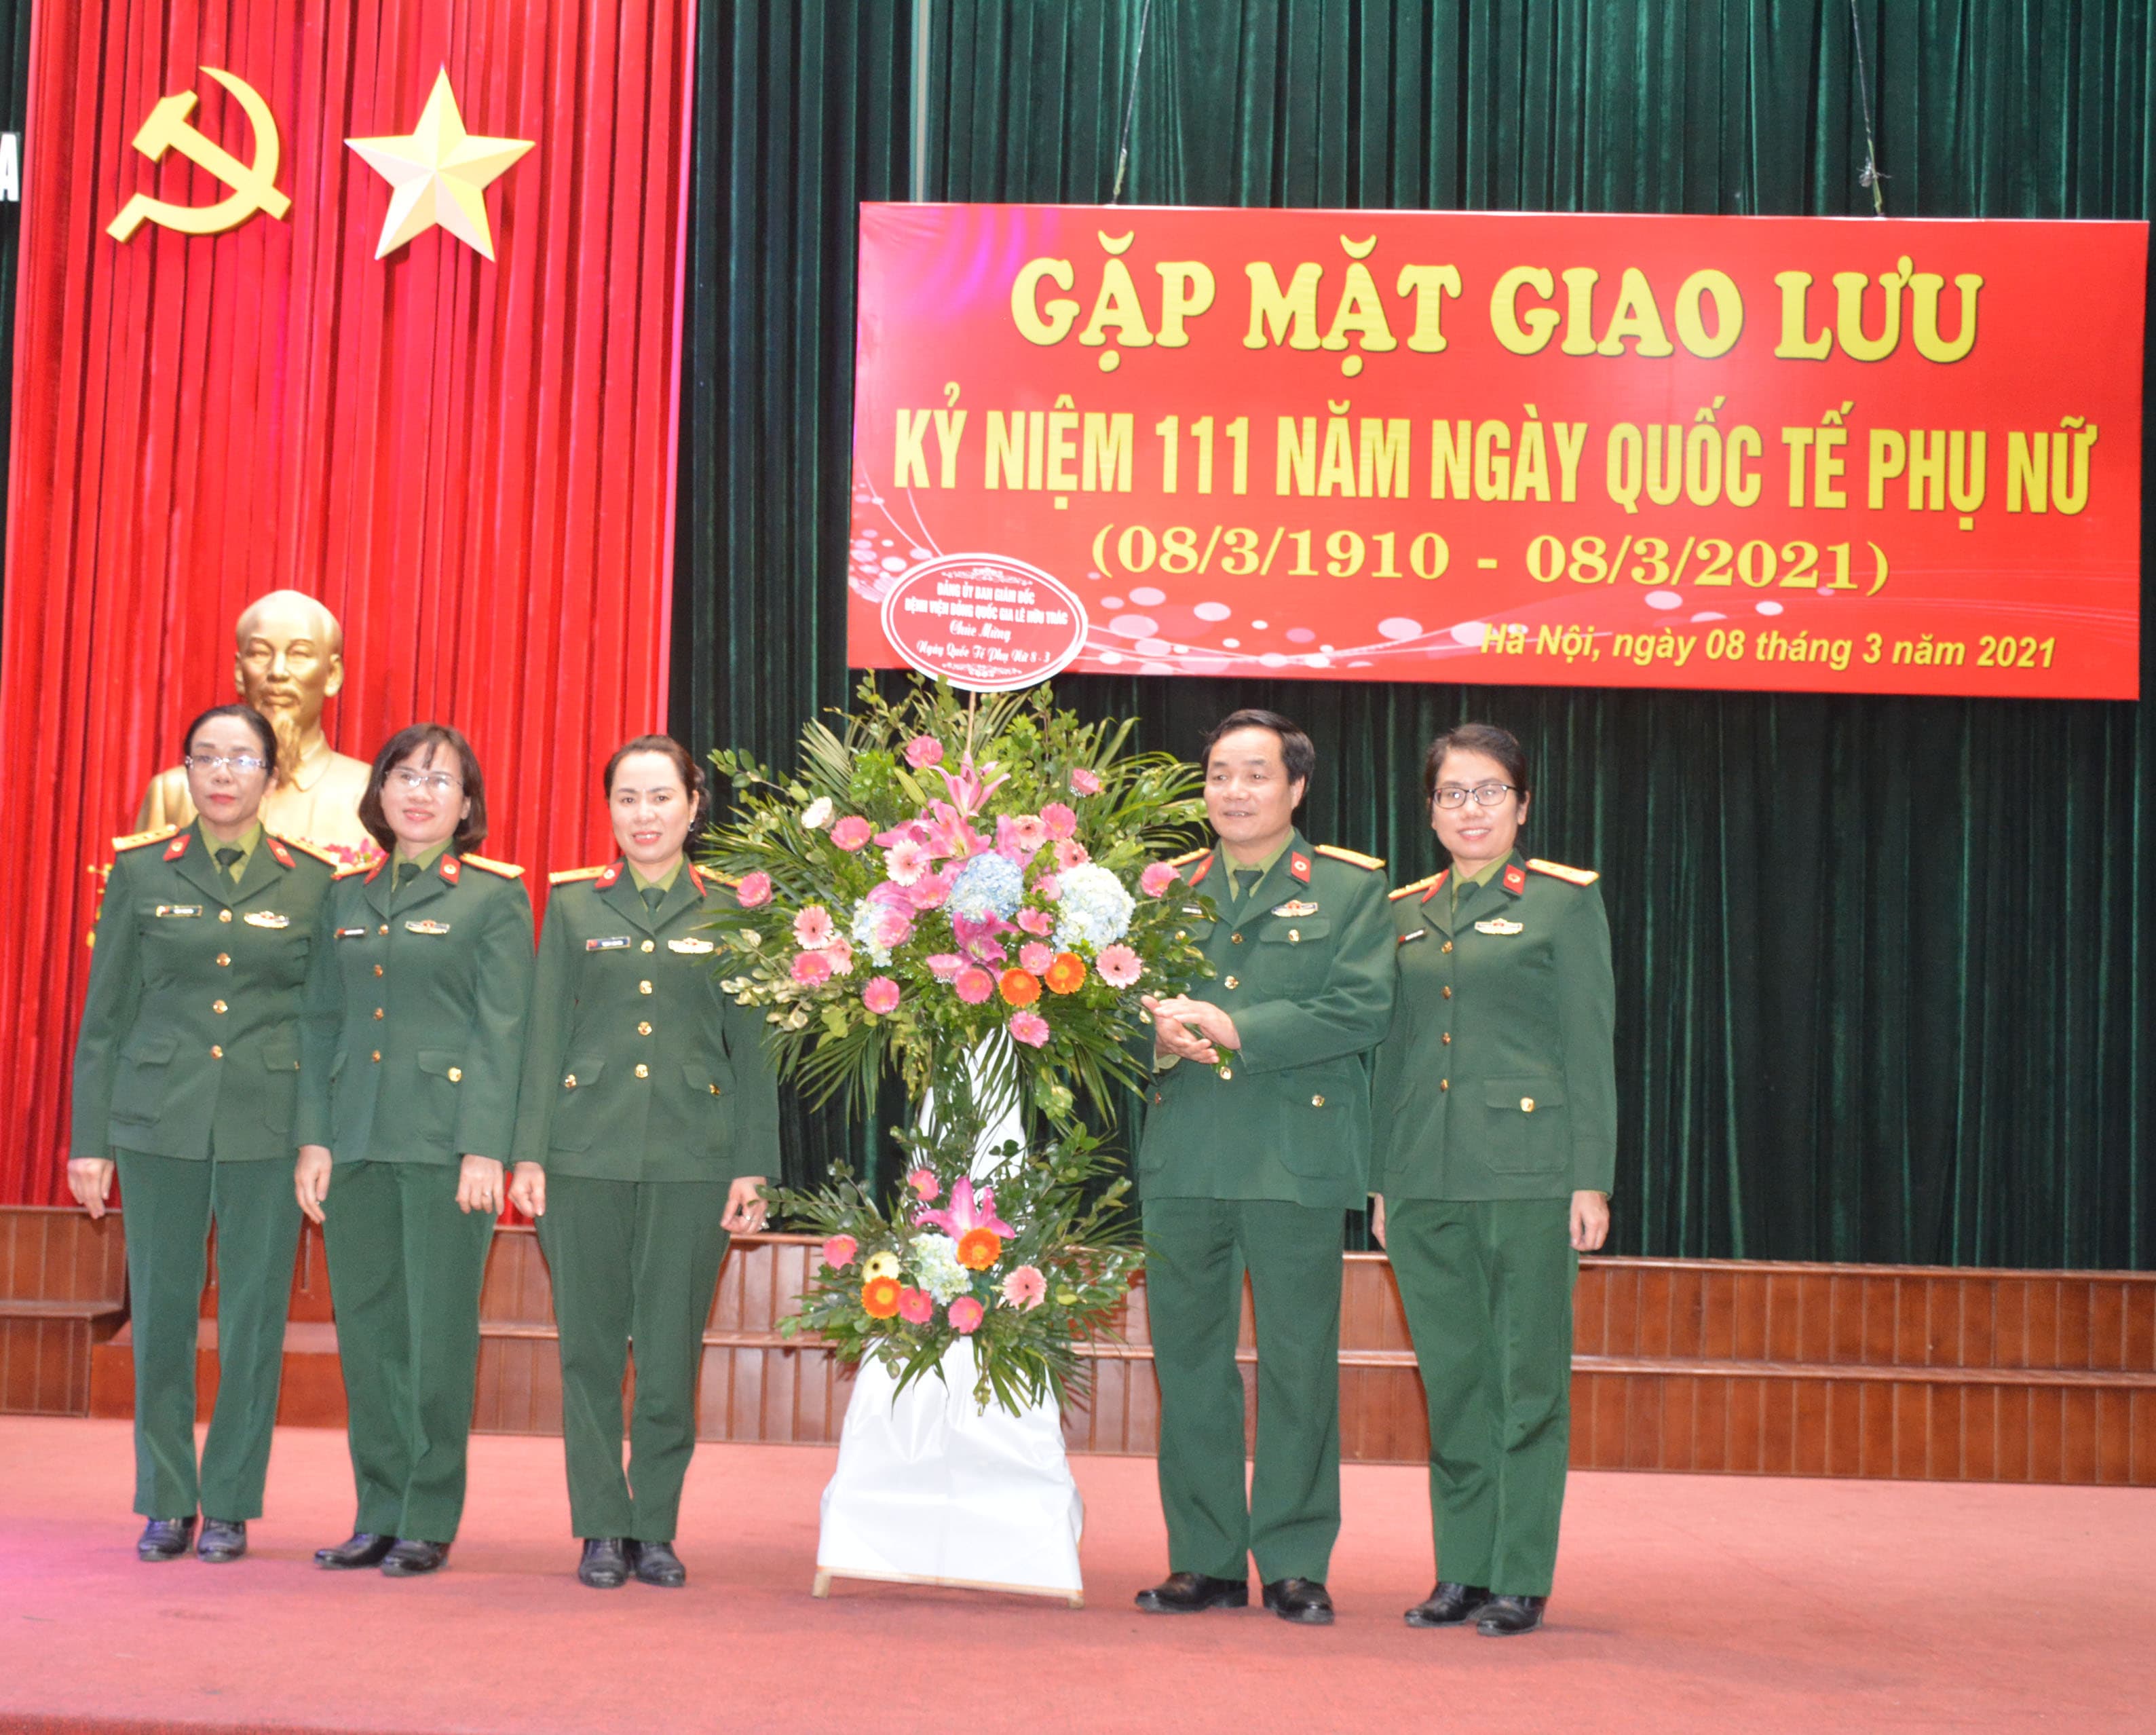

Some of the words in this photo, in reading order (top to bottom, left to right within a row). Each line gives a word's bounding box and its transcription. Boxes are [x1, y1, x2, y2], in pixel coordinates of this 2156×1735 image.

[1011, 230, 1216, 372] GẶP
[1243, 234, 1462, 377] MẶT
[1490, 265, 1743, 358] GIAO
[1774, 255, 1984, 362] LƯU
[894, 381, 968, 489] KỶ
[985, 394, 1135, 510] NIỆM
[1155, 414, 1249, 496] 111
[1276, 399, 1411, 499] NĂM
[1431, 403, 1589, 503] NGÀY
[1606, 395, 1763, 514] QUỐC
[1781, 400, 1855, 509] TẾ
[1868, 428, 1986, 531] PHỤ
[2007, 415, 2098, 515] NỮ
[1091, 523, 1450, 580] (08/3/1910
[1477, 558, 1498, 569] -
[1526, 534, 1889, 596] 08/3/2021)
[1481, 622, 1526, 655] Hà
[1536, 624, 1600, 664] Nội,
[1612, 631, 1697, 667] ngày
[1705, 629, 1746, 660] 08
[1756, 630, 1853, 671] tháng
[1863, 633, 1883, 664] 3
[1892, 633, 1965, 666] năm
[1977, 635, 2057, 668] 2021
